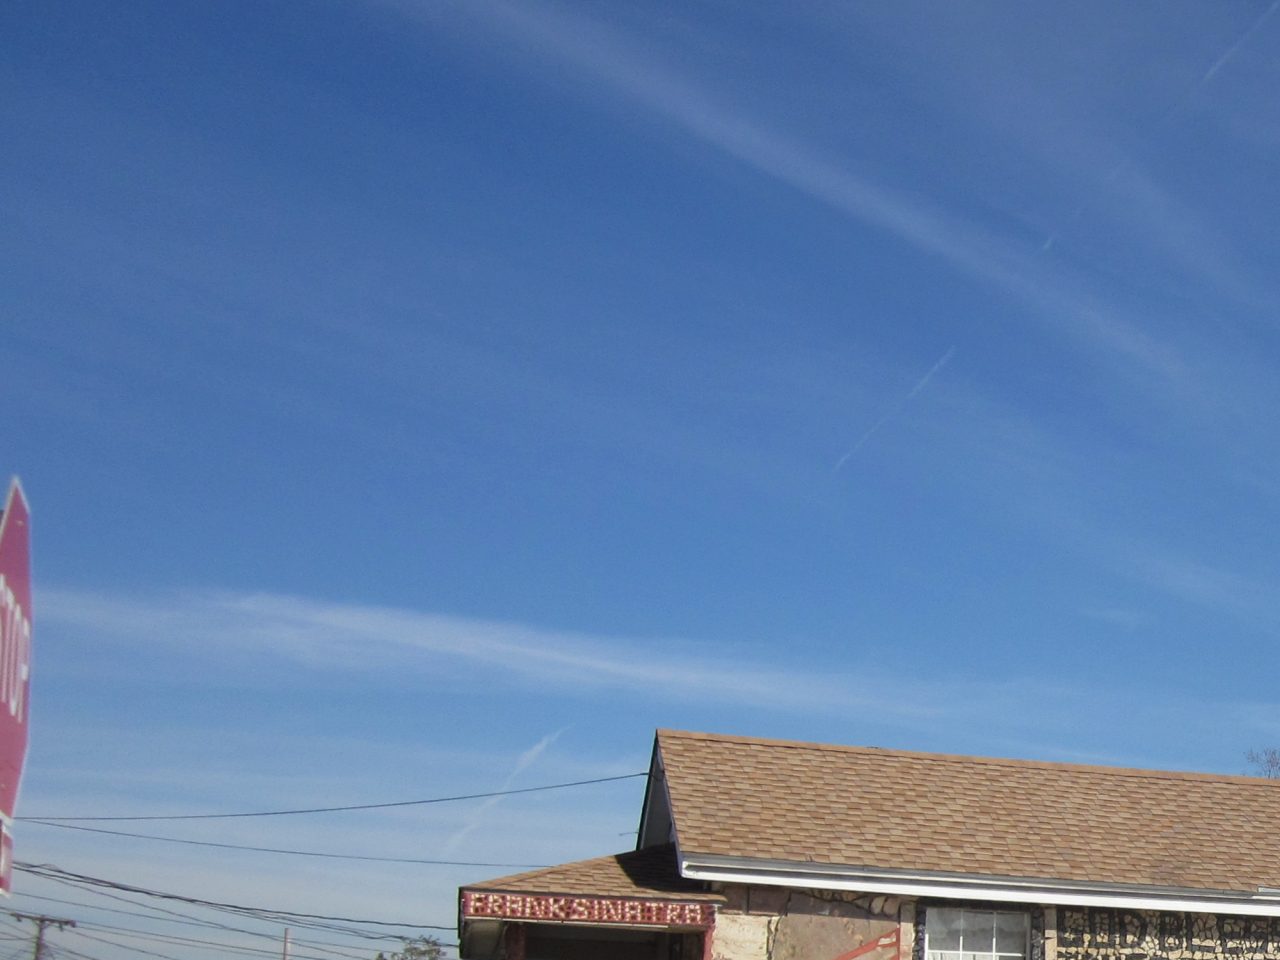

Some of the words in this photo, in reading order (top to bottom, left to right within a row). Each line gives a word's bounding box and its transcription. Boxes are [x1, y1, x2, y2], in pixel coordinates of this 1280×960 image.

[0, 573, 31, 724] TOP
[469, 893, 566, 918] FRANK
[571, 898, 701, 925] SINATRA
[1057, 906, 1148, 950] GOD
